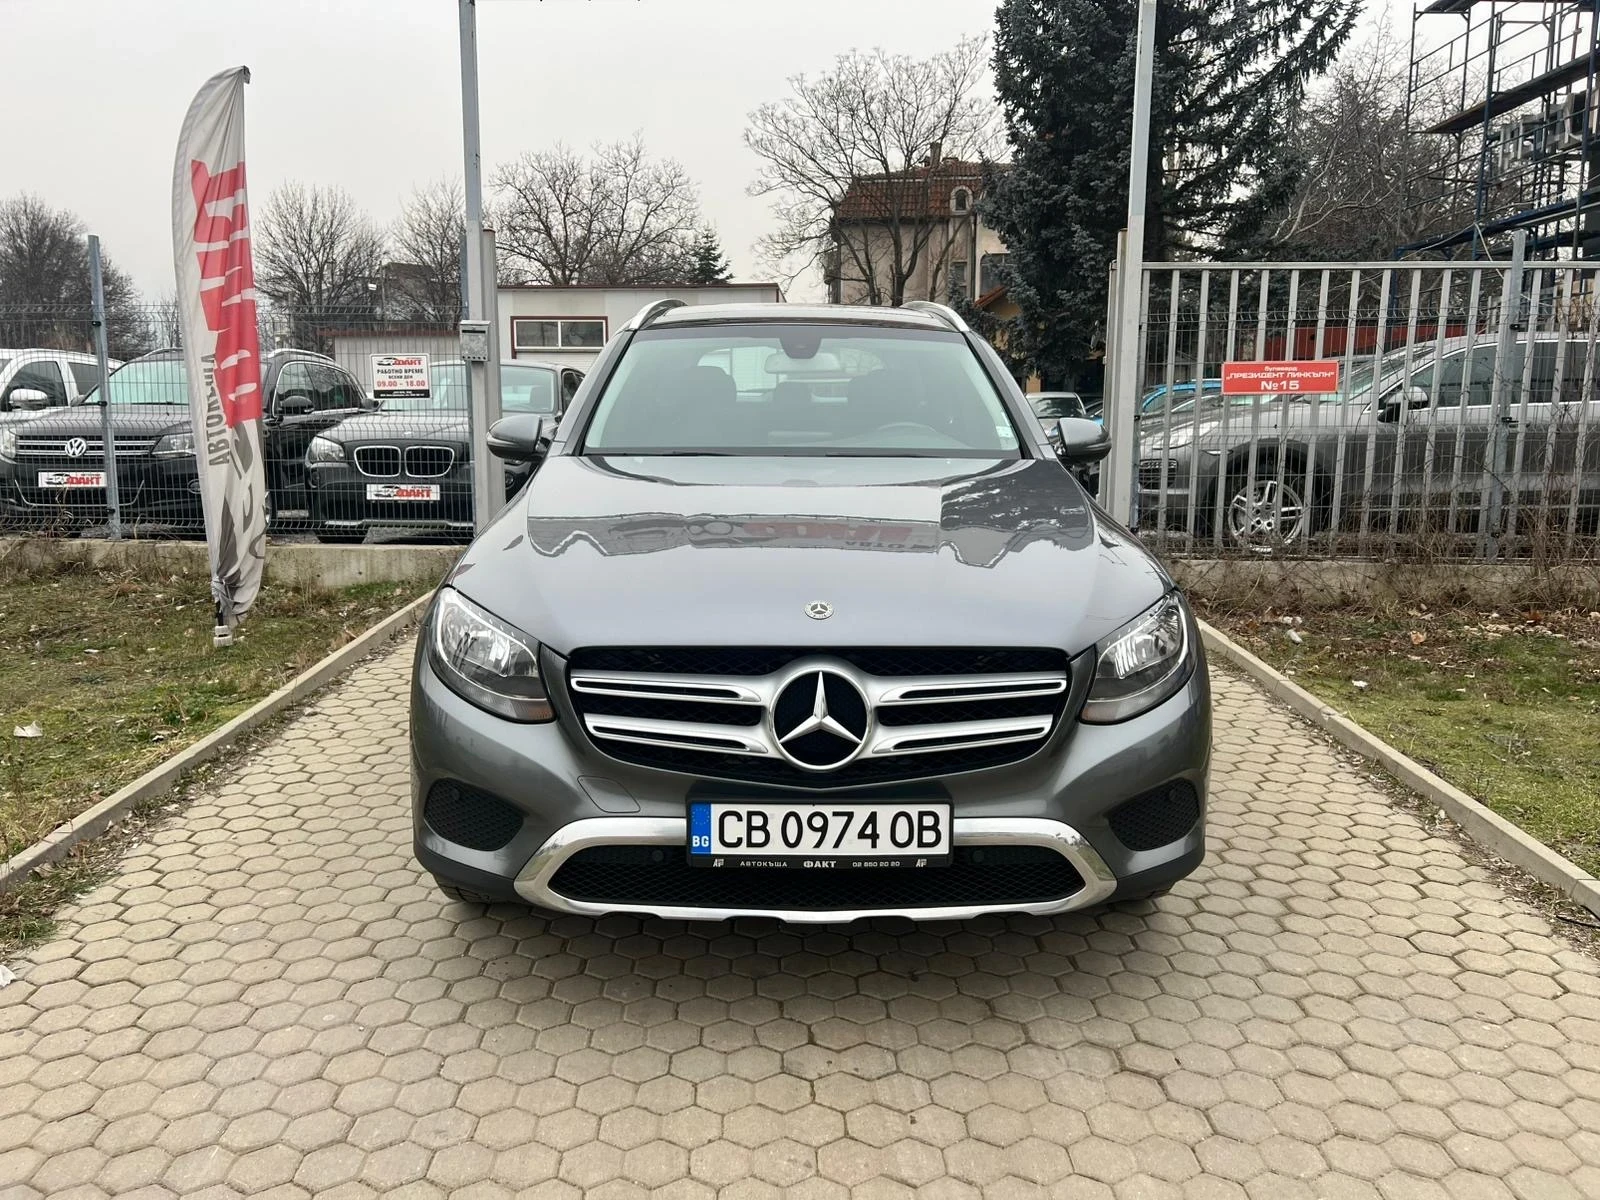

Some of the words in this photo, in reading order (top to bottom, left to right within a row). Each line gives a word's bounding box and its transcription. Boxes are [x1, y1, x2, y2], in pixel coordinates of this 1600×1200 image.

[376, 380, 398, 388] 09.00
[718, 810, 771, 849] CB
[780, 810, 880, 849] 0974
[692, 835, 710, 848] BG
[803, 860, 837, 868] ФАКТ
